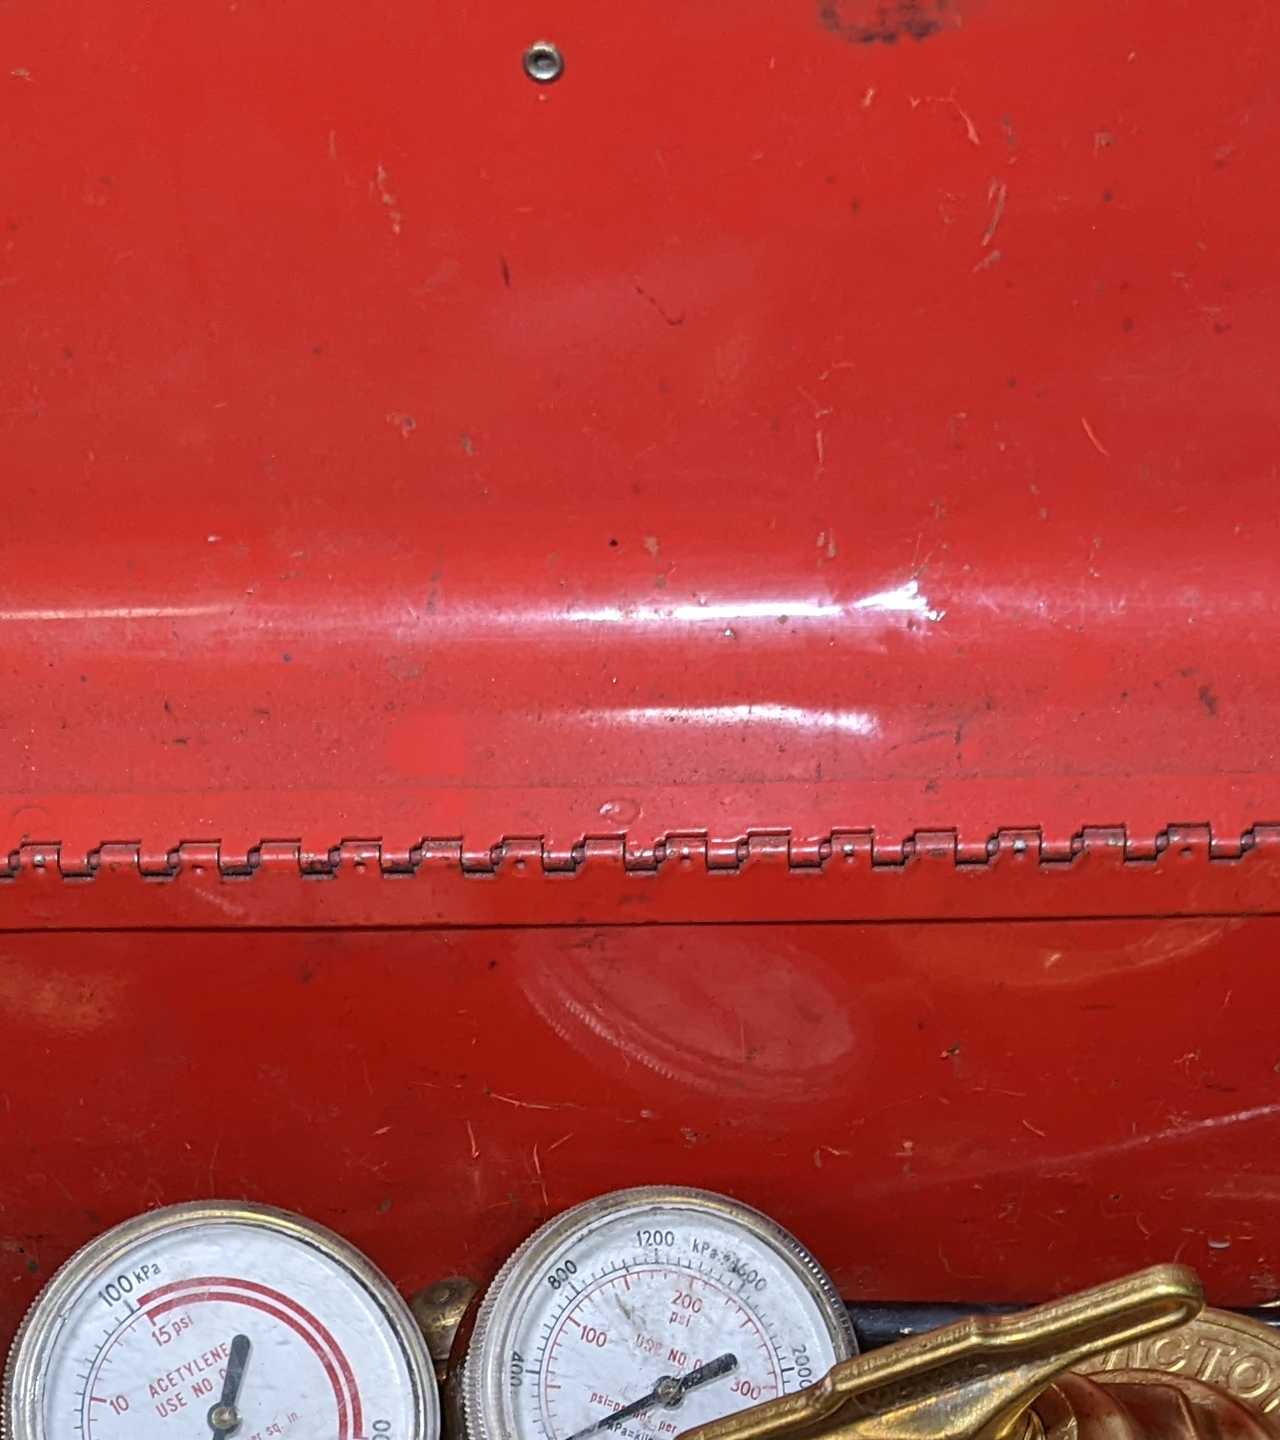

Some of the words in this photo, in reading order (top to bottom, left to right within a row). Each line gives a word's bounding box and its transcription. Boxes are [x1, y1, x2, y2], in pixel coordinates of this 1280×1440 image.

[636, 1229, 676, 1248] 1200
[692, 1238, 719, 1259] kPa
[98, 1274, 134, 1307] 100
[133, 1263, 162, 1285] kPa
[547, 1259, 579, 1291] 800
[671, 1289, 704, 1315] 200
[151, 1326, 172, 1347] 15
[171, 1312, 194, 1337] psi
[669, 1312, 693, 1329] psi
[580, 1324, 608, 1348] 100
[148, 1342, 231, 1400] ACETYLENE
[667, 1347, 688, 1367] NO
[109, 1394, 130, 1416] 10
[155, 1392, 188, 1419] USE
[191, 1378, 214, 1399] NO
